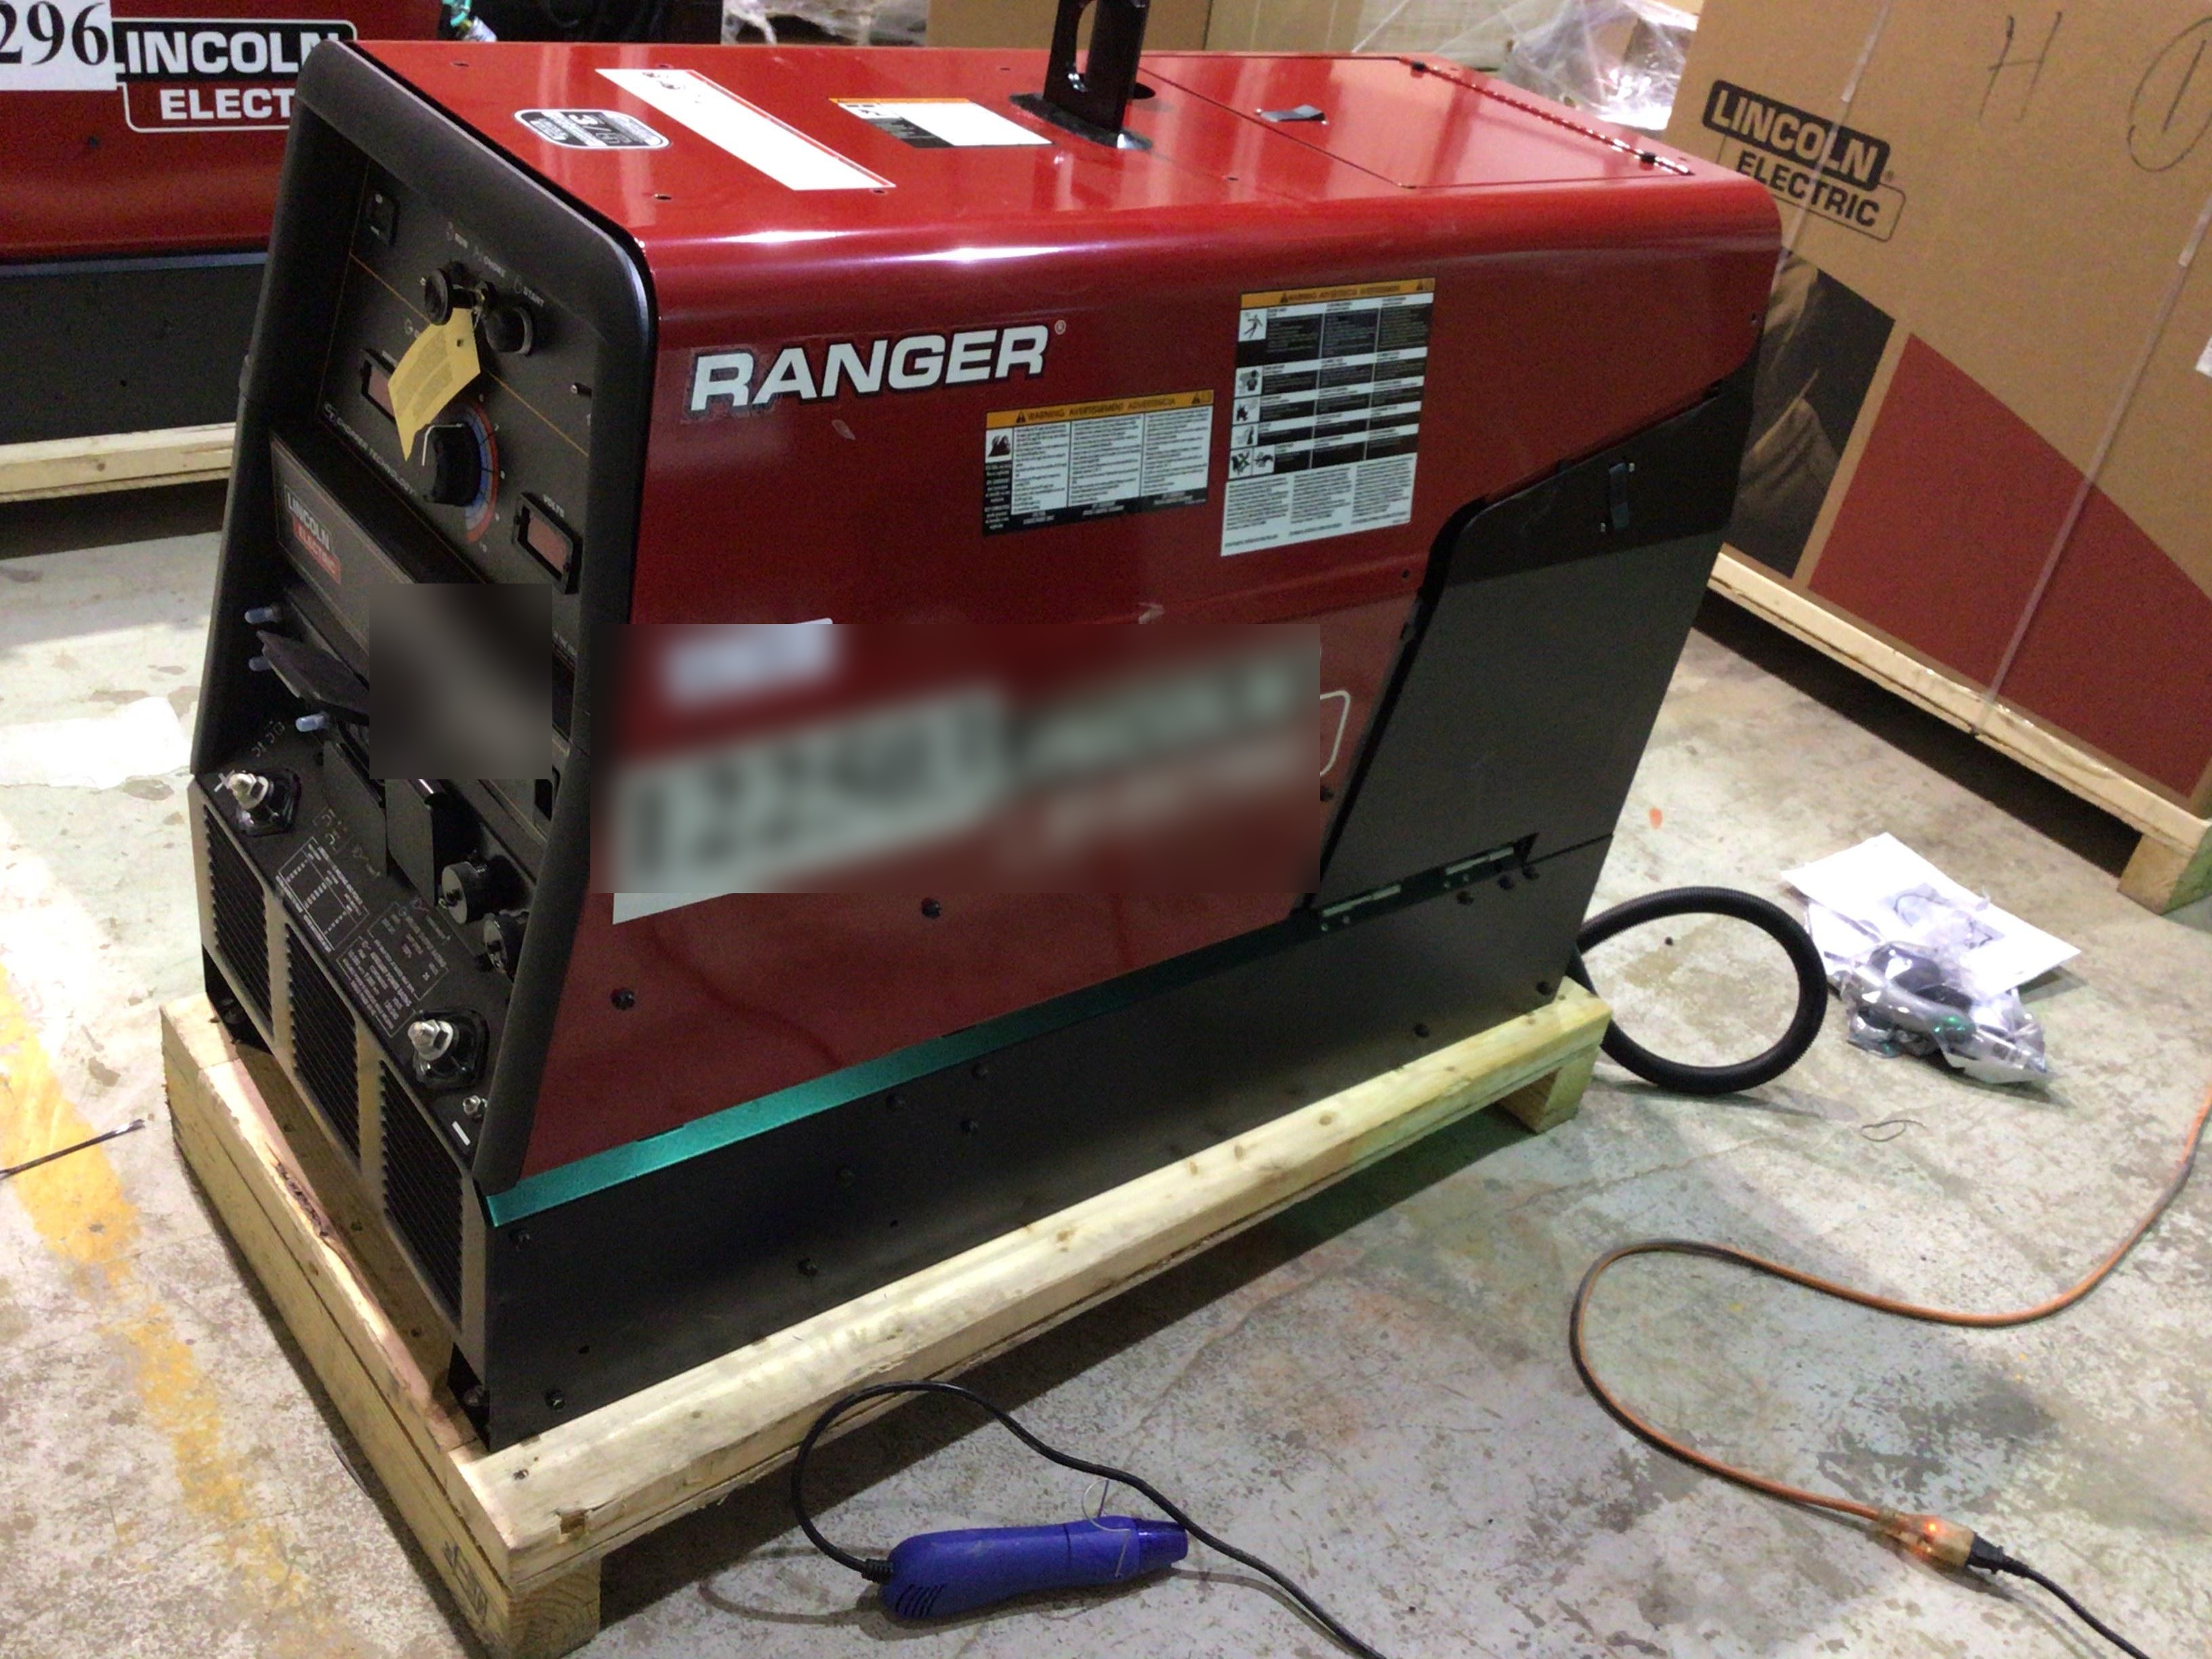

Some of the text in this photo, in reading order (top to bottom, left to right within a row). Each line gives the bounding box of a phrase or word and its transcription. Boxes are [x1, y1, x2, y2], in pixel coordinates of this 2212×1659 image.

[115, 31, 339, 74] INCOL
[1737, 150, 1880, 227] ELECTRIC
[690, 325, 1048, 411] RANGER
[287, 492, 331, 552] LINCOLN
